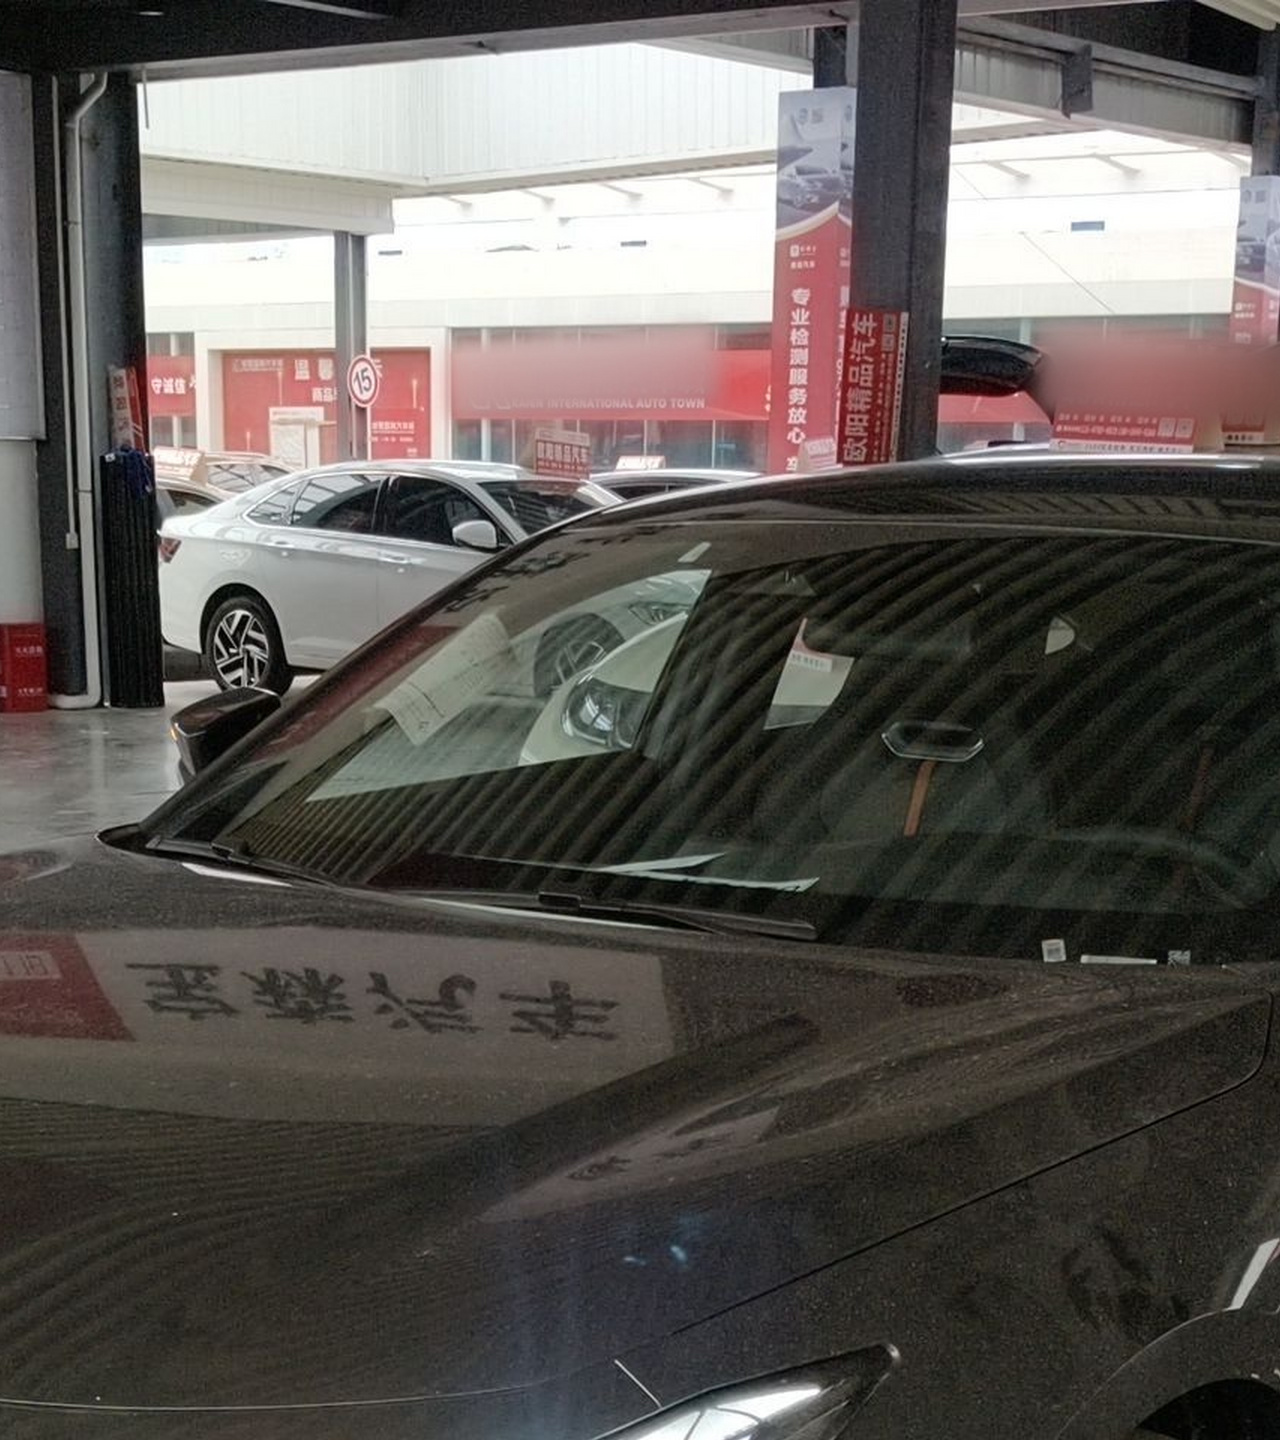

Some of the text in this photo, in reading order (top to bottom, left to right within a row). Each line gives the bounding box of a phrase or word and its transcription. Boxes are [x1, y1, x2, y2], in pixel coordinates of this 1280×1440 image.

[353, 367, 372, 395] 15
[844, 313, 878, 462] 欧阳精品汽车
[547, 398, 634, 409] INTERNATIONAL
[636, 398, 667, 409] AUTO
[671, 398, 705, 409] TOWN
